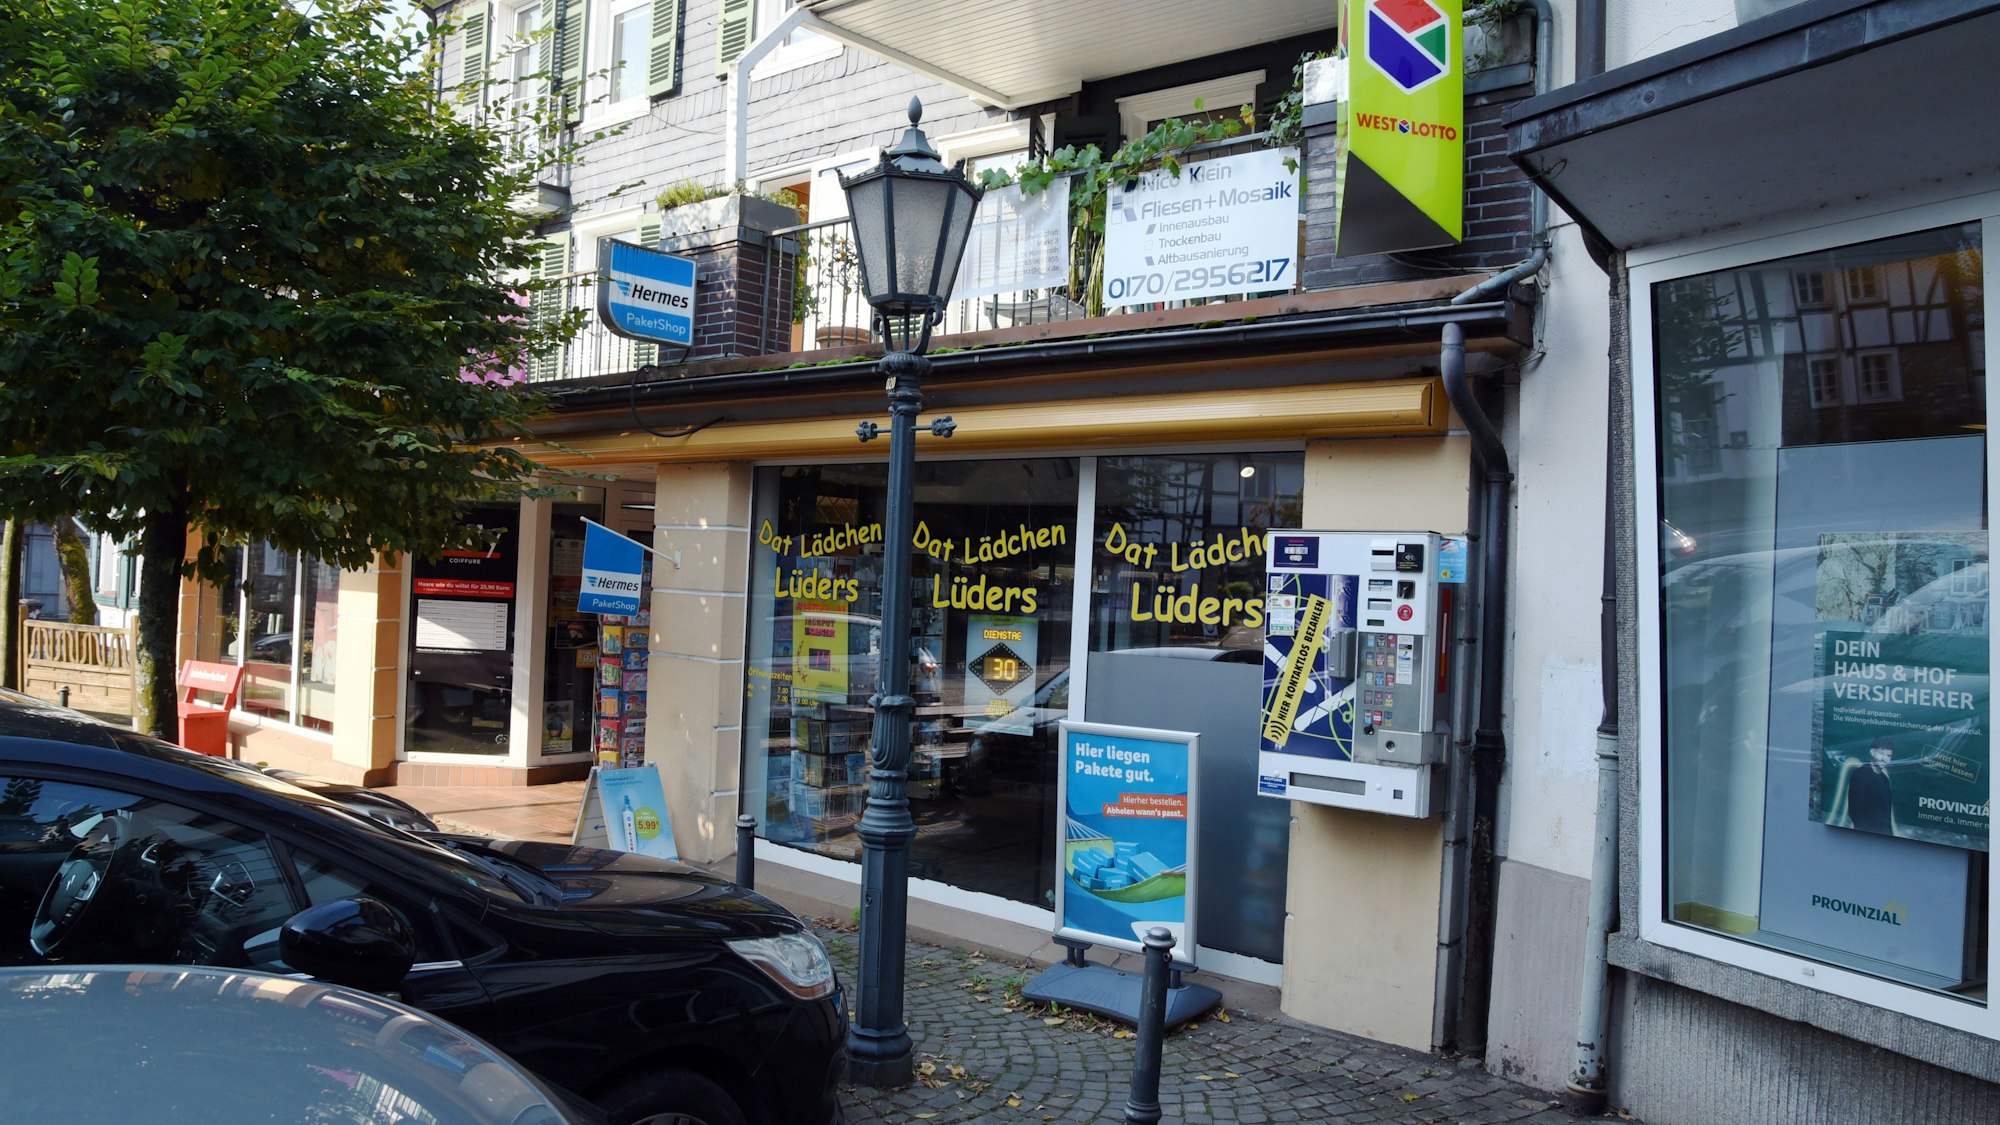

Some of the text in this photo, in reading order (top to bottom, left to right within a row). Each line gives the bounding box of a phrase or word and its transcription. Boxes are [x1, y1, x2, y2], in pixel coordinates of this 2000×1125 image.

[1357, 112, 1457, 141] WEST LOTTO
[1143, 163, 1232, 192] Nico Klein
[1159, 215, 1229, 232] Innenausbau
[1159, 233, 1221, 248] Trockenbau
[1158, 246, 1249, 265] Altbausanierung
[1108, 258, 1290, 299] 0170/2956217
[632, 284, 688, 308] Hermes
[627, 312, 686, 336] PaketShop
[758, 519, 882, 558] Dat Lädchen
[912, 521, 1066, 564] Dat Lädchen
[1105, 522, 1269, 572] Dat Lädch
[598, 577, 639, 591] Hermes
[775, 567, 858, 602] Lüders
[933, 573, 1037, 613] Lüders
[592, 598, 636, 611] PaketShop
[1131, 582, 1264, 628] Lüders
[1277, 600, 1325, 721] HIER KONTAKTLOS BEZAHLEN
[1835, 640, 1880, 658] DEIN
[993, 658, 1016, 681] 30
[1834, 661, 1957, 685] HAUS & HOF
[1833, 682, 1974, 710] VERSICHERER
[1833, 706, 1901, 719] Individuell anpassbar:
[1844, 715, 1932, 732] Wohngebäudeversicherung
[1933, 724, 1945, 732] der
[1946, 726, 1982, 736] Provinzial.
[1075, 742, 1150, 765] Hier liegen
[1953, 758, 1967, 768] hier
[1075, 760, 1154, 783] Pakete gut.
[1951, 765, 1974, 779] lassen
[1106, 806, 1184, 818] Abholen wann's passt.
[1123, 796, 1184, 807] Hierher bestellen.
[1919, 796, 1990, 817] PROVINZIA
[1918, 811, 1942, 821] Immer
[1944, 815, 1955, 824] da.
[1957, 817, 1982, 828] Immer
[1812, 894, 1901, 926] PROVINZIAL
